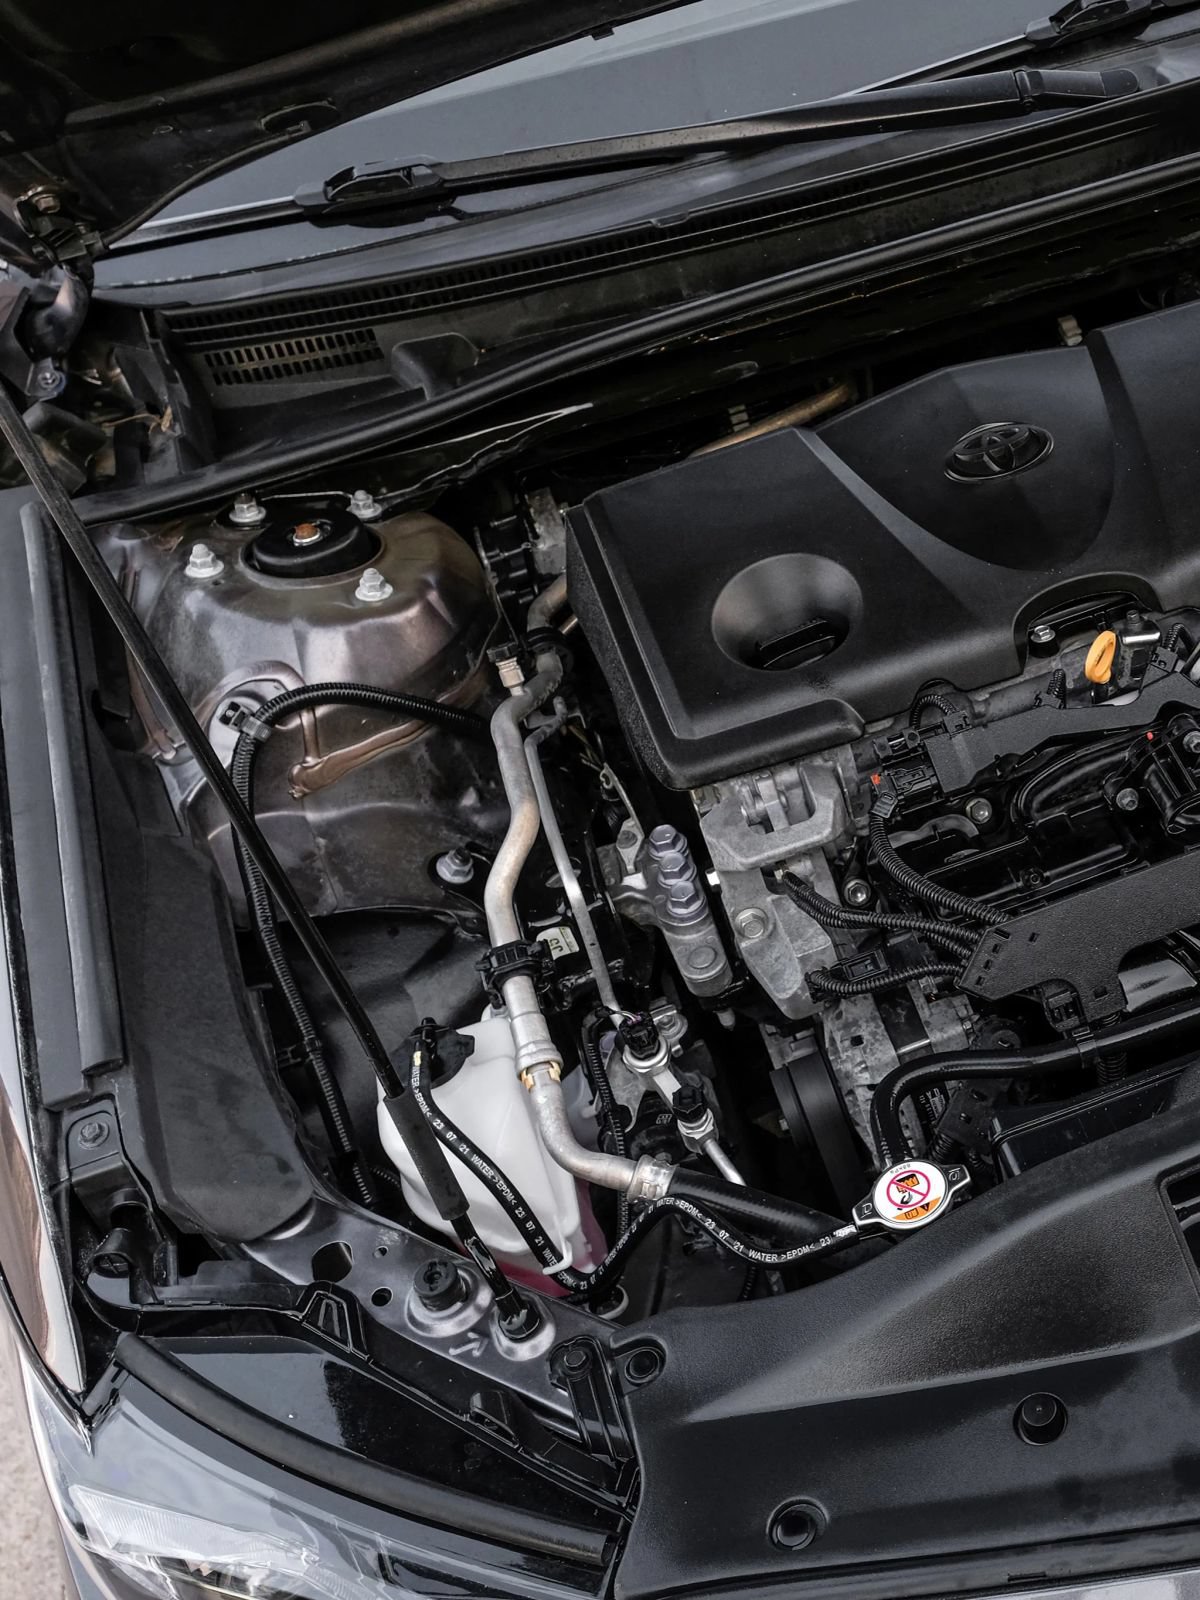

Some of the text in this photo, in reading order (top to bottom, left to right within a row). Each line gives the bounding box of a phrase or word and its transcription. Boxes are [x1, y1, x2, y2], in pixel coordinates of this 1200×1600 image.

[411, 1066, 420, 1089] WATER
[432, 1119, 445, 1130] 23
[445, 1131, 457, 1142] 07
[471, 1154, 495, 1179] WATER
[492, 1176, 517, 1206] >EPDM<
[514, 1207, 525, 1219] 23
[525, 1221, 536, 1233] 07
[534, 1235, 545, 1247] 21
[542, 1247, 560, 1267] WATE
[557, 1271, 577, 1288] EPDM<
[579, 1280, 587, 1290] 23
[656, 1197, 674, 1208] WATER
[675, 1199, 703, 1219] >EPDM<
[704, 1218, 716, 1230] 23
[718, 1229, 729, 1241] 07
[748, 1248, 778, 1262] WATER
[780, 1244, 815, 1260] >EPDM<
[821, 1236, 831, 1247] 23
